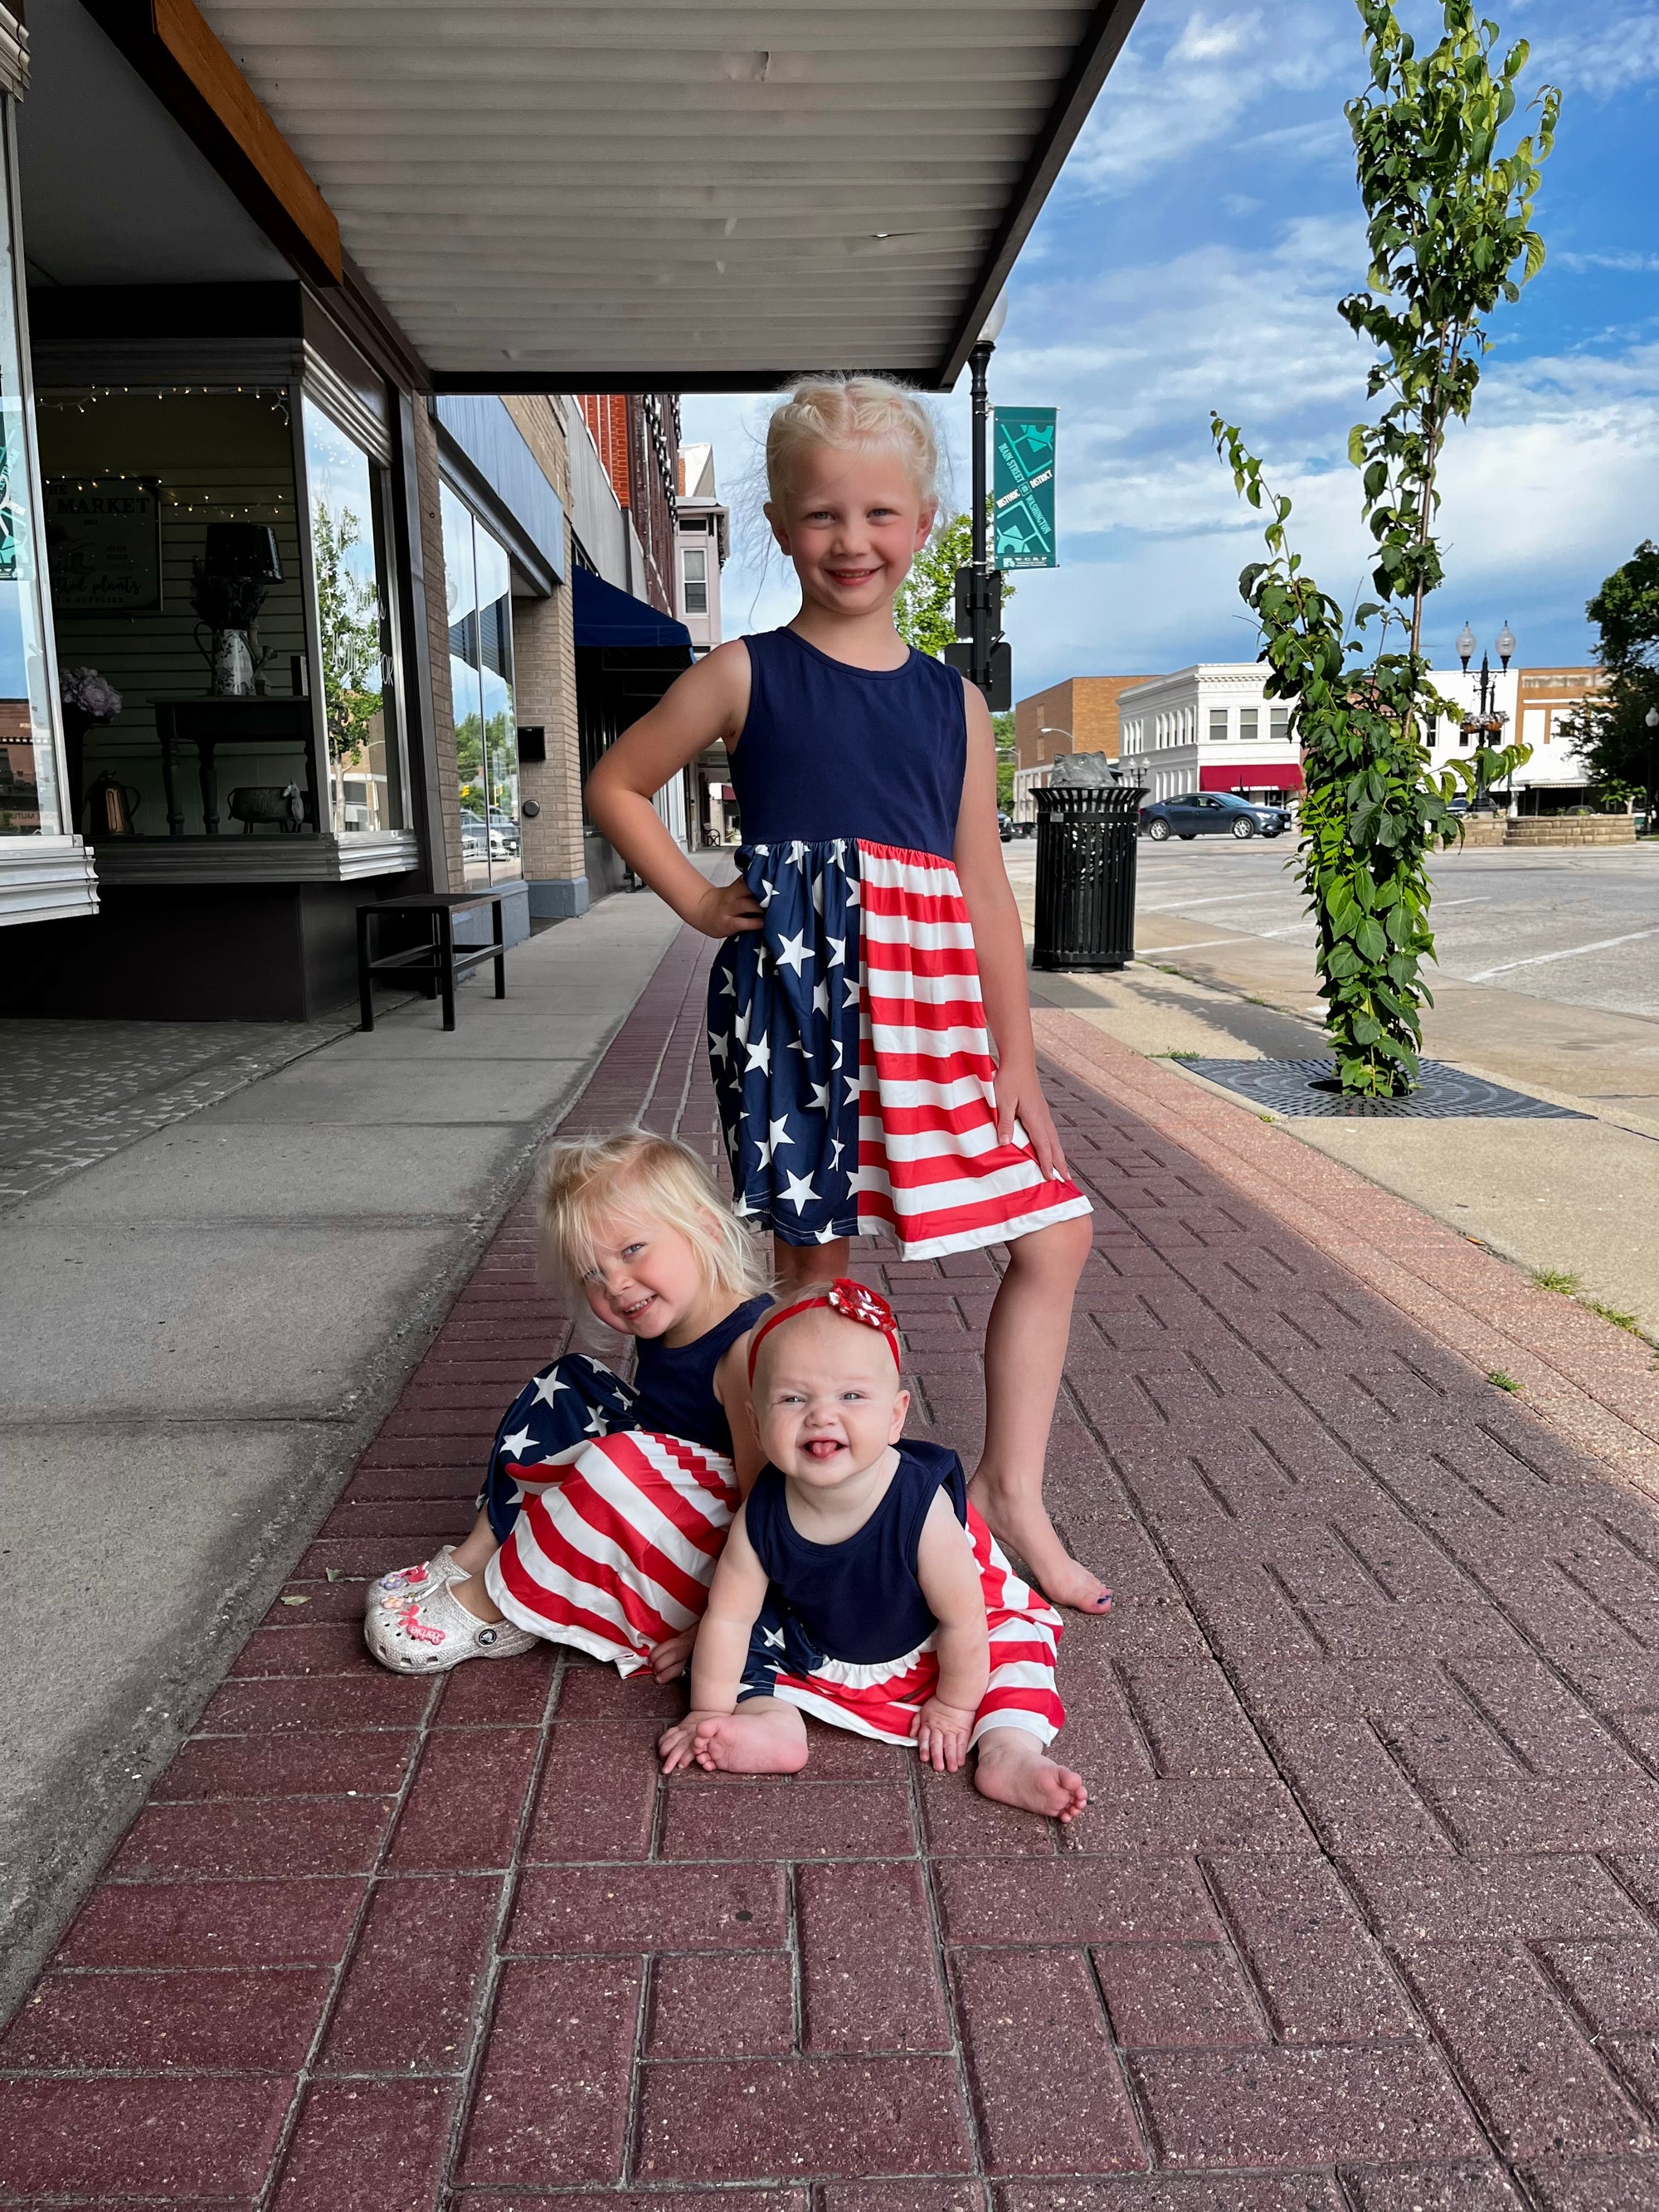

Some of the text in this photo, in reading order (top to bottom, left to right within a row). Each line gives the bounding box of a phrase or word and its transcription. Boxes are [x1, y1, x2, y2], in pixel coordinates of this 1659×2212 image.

[995, 489, 1020, 508] HISTORIC
[1029, 469, 1053, 489] DISTRICT
[998, 443, 1014, 461] MAIN
[1006, 459, 1025, 483] STREET
[1025, 494, 1052, 535] WASHINGTON
[56, 497, 150, 514] MARKET
[92, 575, 142, 596] plants
[410, 1626, 444, 1644] Barbie
